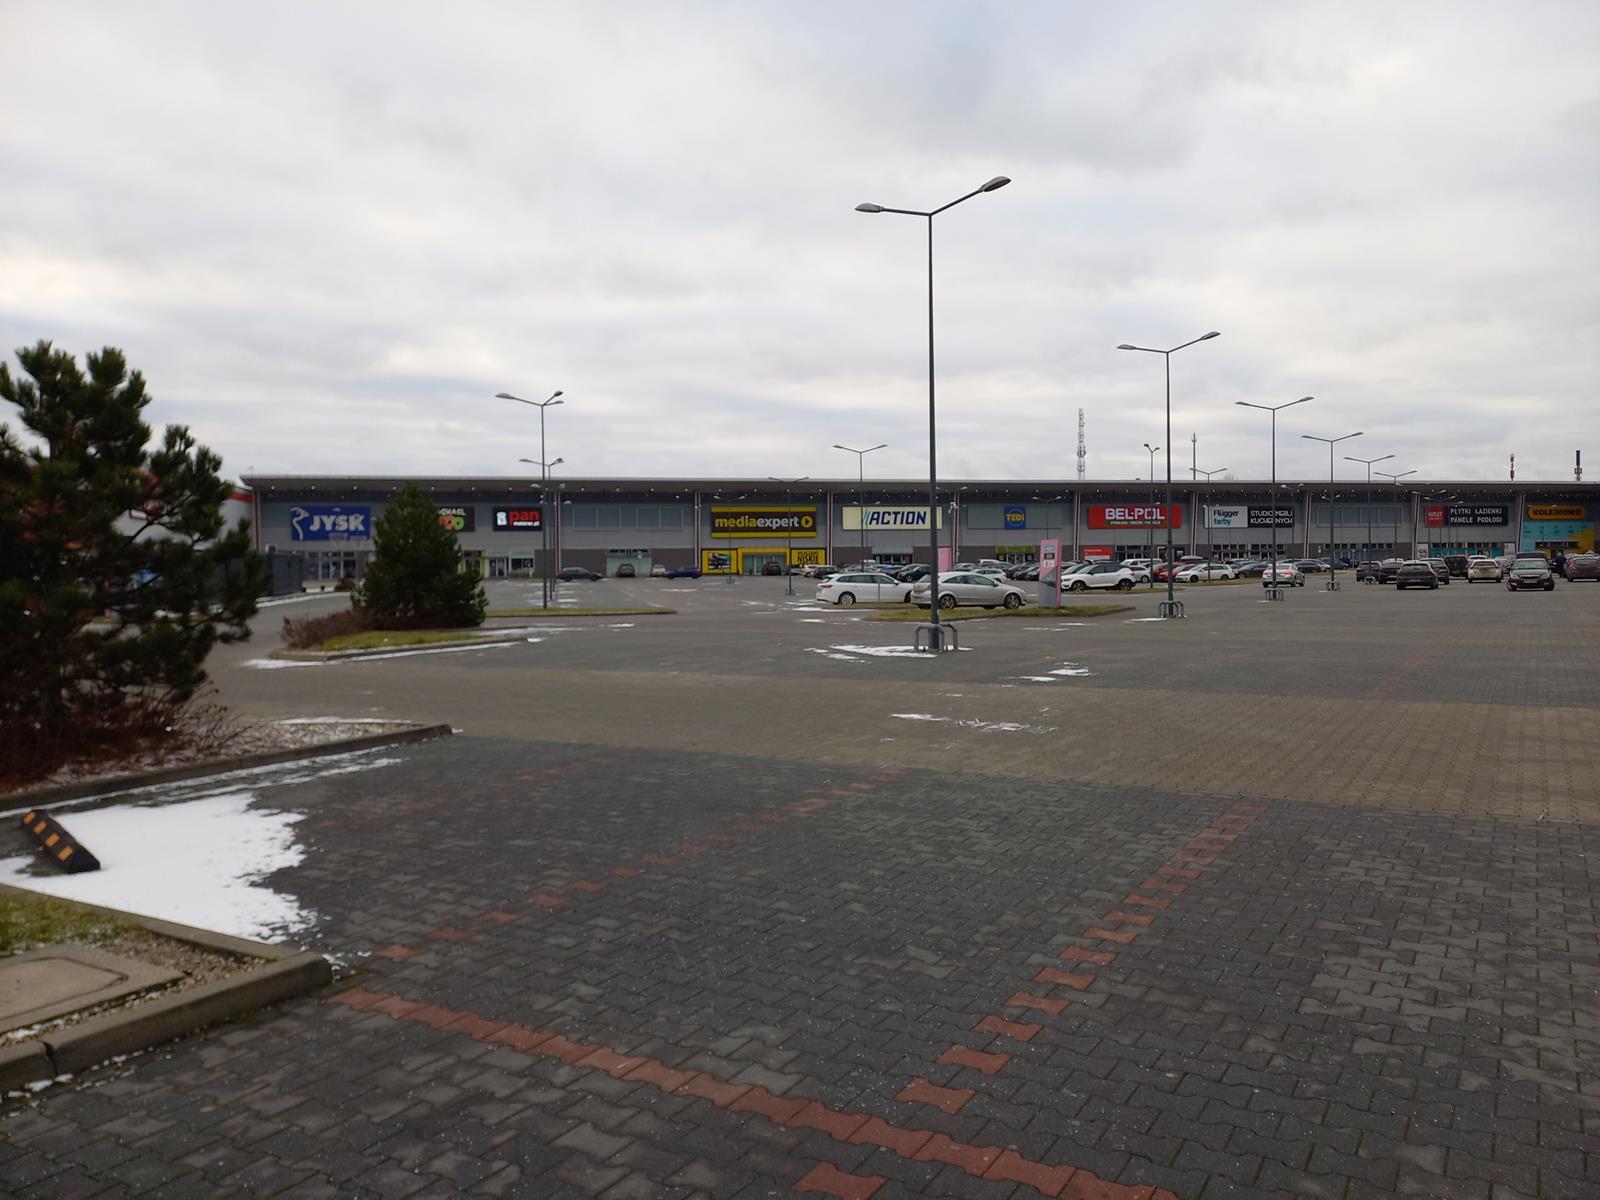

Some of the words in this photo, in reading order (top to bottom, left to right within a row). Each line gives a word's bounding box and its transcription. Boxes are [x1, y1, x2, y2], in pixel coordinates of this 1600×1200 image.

[509, 511, 539, 528] pan
[869, 511, 927, 525] ACTION
[1213, 509, 1239, 518] Flügger
[309, 514, 365, 531] JYSK
[715, 516, 799, 529] mediaexpert
[1214, 518, 1231, 526] farby
